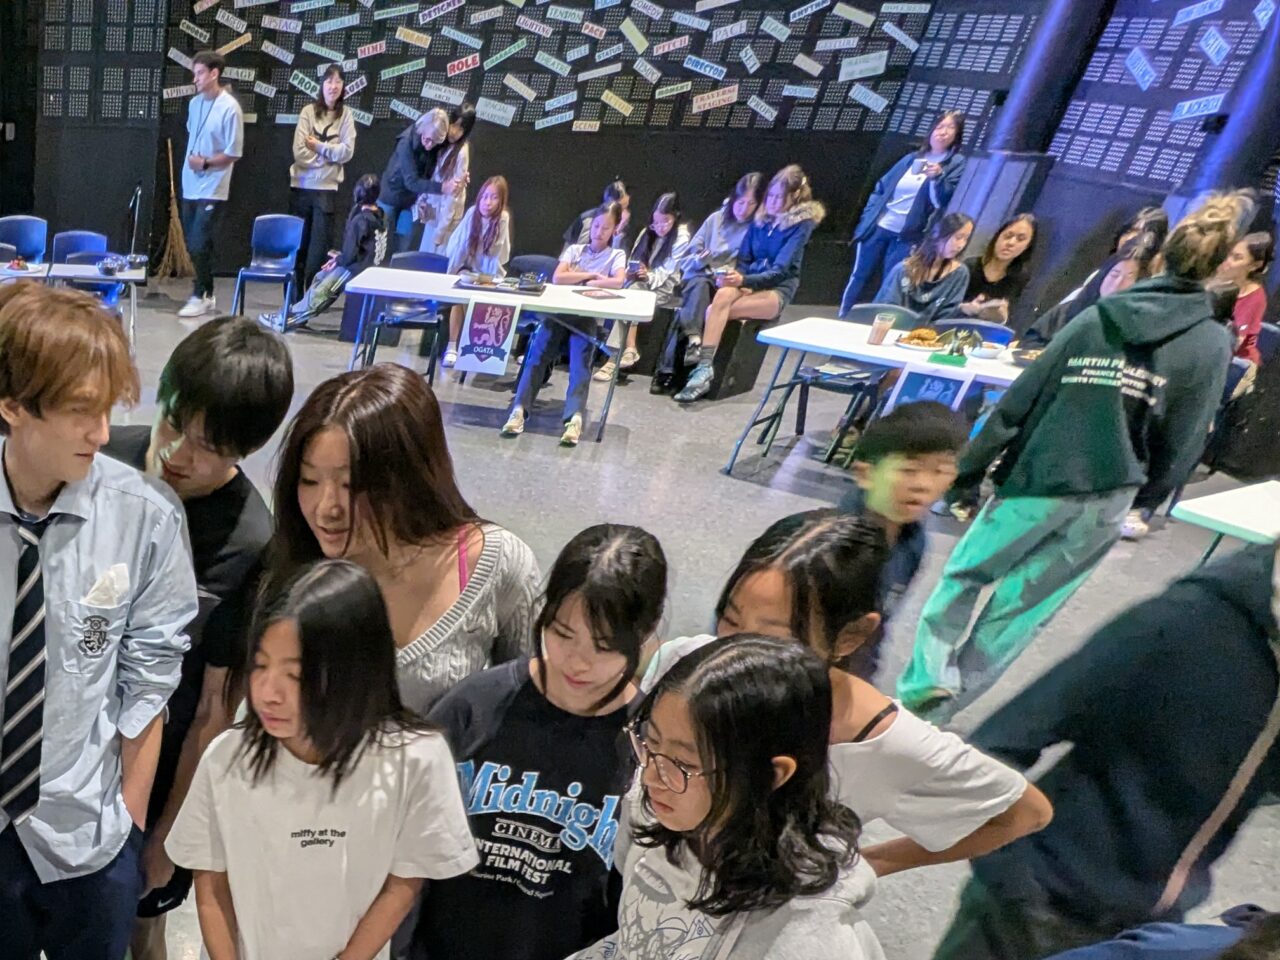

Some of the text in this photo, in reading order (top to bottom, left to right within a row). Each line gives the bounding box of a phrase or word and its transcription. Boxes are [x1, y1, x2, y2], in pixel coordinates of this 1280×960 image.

[218, 10, 246, 32] TRAGEDY
[262, 16, 301, 33] UPSTAGE
[472, 8, 502, 23] ACTION
[518, 16, 551, 36] LIGHTING
[584, 24, 605, 38] PACE
[714, 22, 746, 41] PACE
[359, 42, 385, 57] MIME
[448, 56, 479, 75] ROLE
[686, 57, 725, 79] DIRECTOR
[742, 47, 758, 73] SET
[255, 82, 276, 97] PLOT
[750, 97, 776, 119] PROPS
[574, 121, 599, 131] SCENE
[473, 346, 494, 355] OGATA
[1067, 357, 1111, 368] MARTIN
[291, 829, 346, 838] miffy at the
[494, 822, 562, 850] CINEMA
[300, 838, 335, 848] gallery
[475, 838, 572, 874] NTERNATIONAL
[485, 854, 551, 885] FILM FEST
